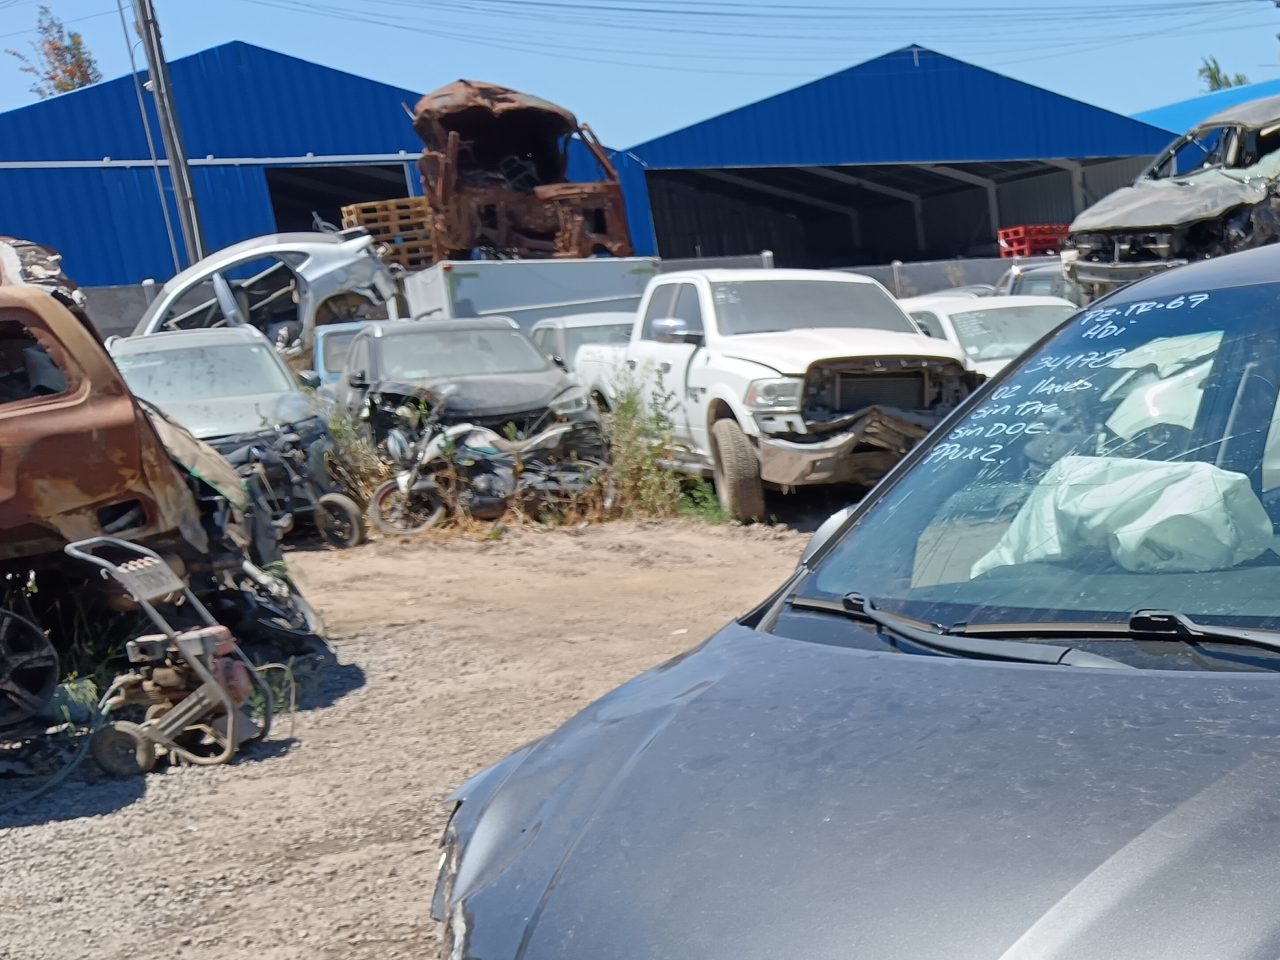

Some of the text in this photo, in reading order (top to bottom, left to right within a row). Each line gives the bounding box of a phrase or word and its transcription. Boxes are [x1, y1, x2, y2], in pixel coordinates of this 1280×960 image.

[991, 384, 1022, 401] 02
[971, 403, 1011, 420] sin
[949, 423, 984, 441] sin
